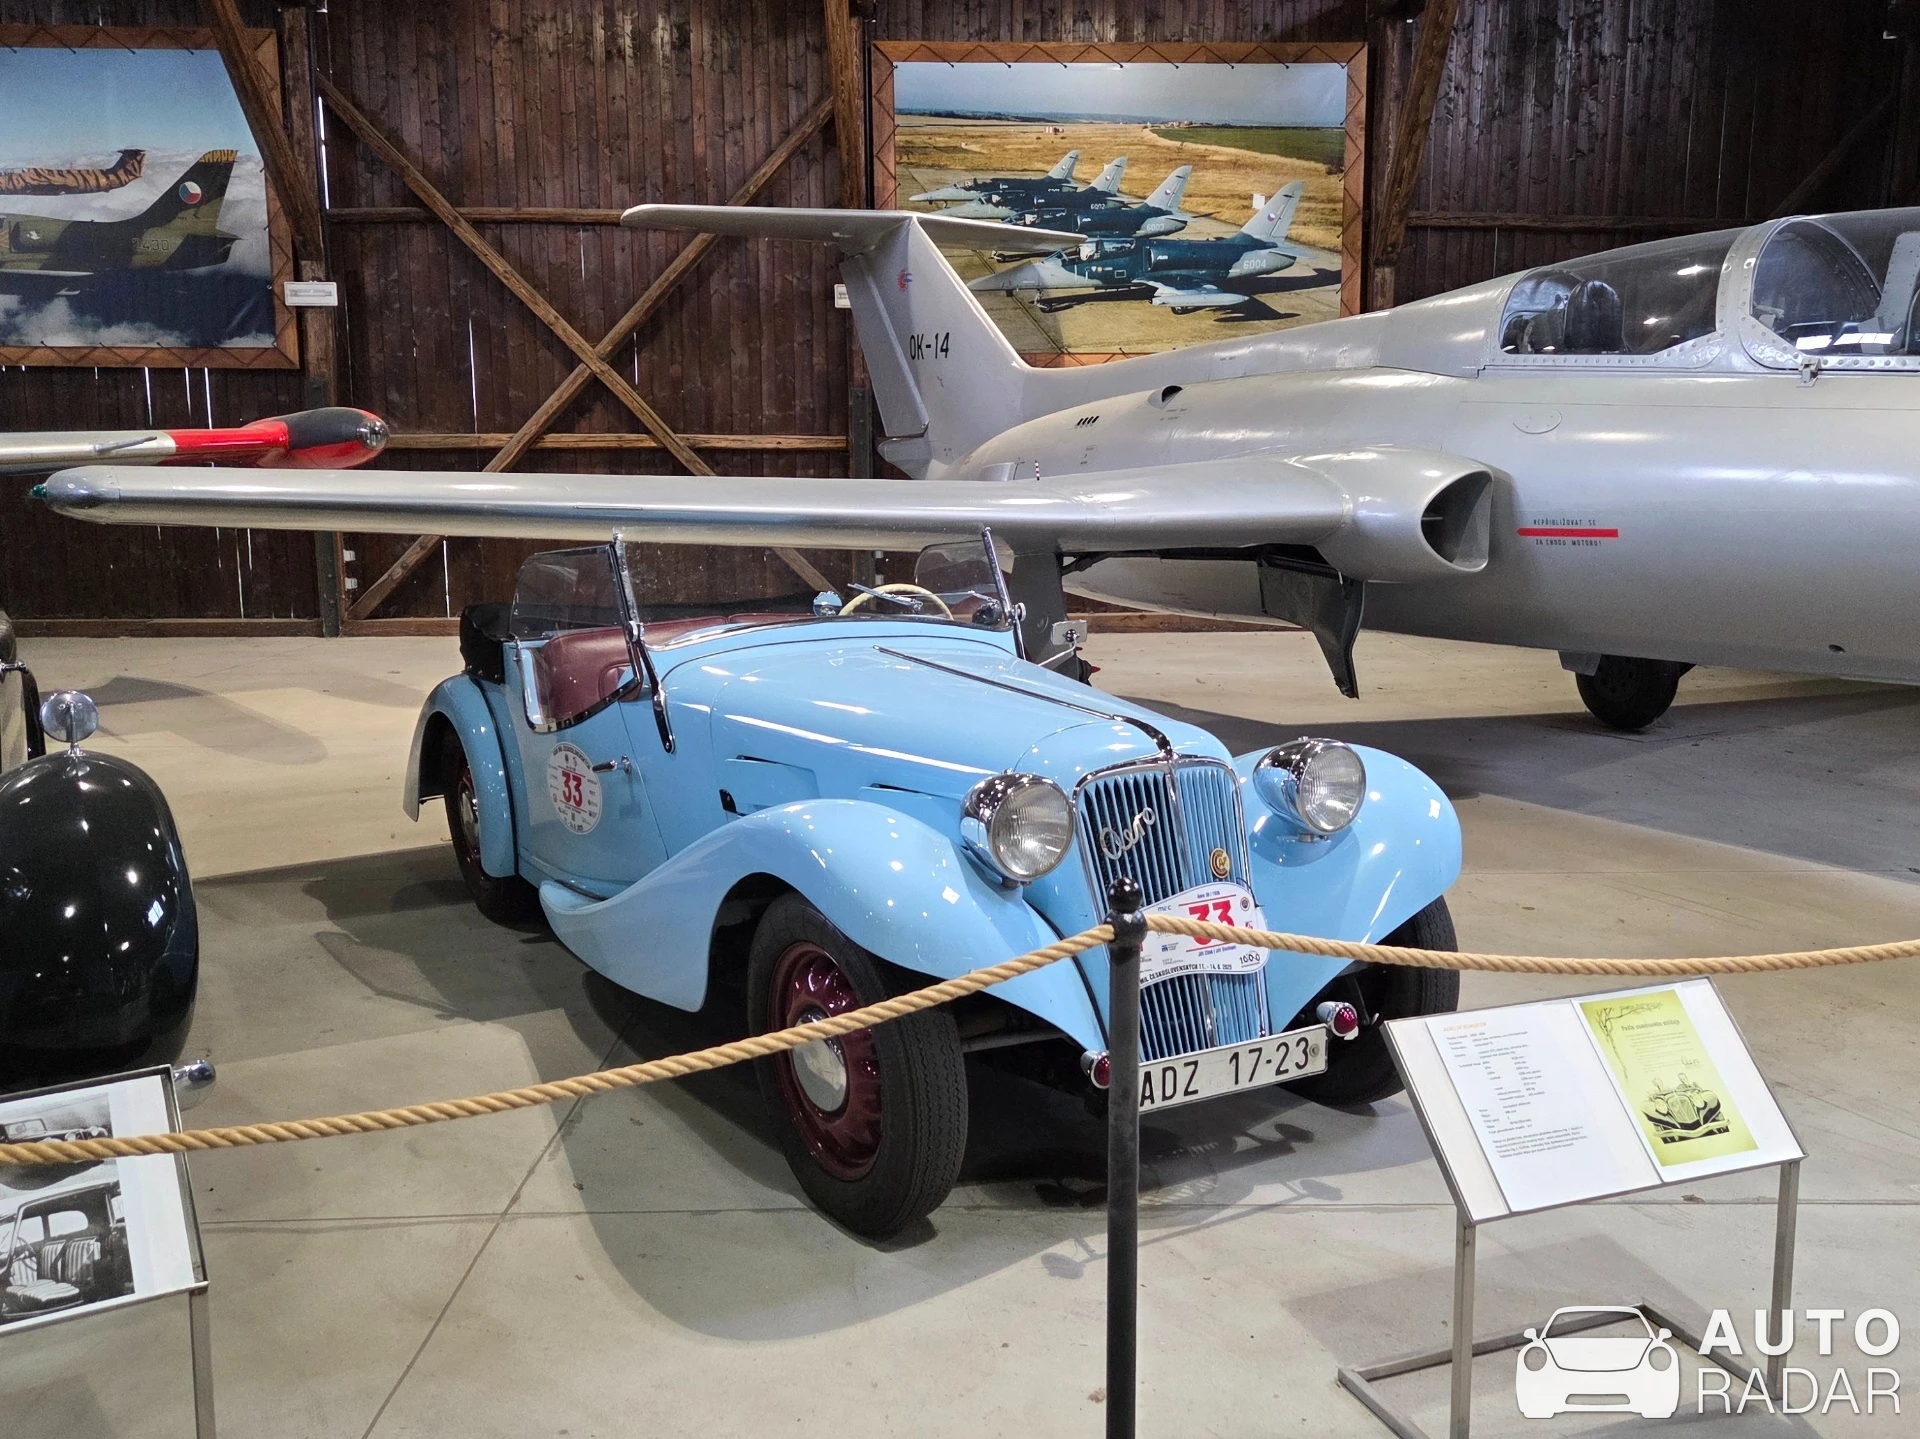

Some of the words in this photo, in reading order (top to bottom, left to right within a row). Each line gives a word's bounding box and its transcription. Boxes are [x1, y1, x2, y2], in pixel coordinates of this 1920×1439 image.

[1243, 259, 1266, 270] 6004
[909, 331, 950, 361] OK-14
[561, 770, 583, 808] 33
[1188, 900, 1235, 945] 33
[1139, 1060, 1199, 1107] ADZ
[1229, 1036, 1309, 1086] 17-23
